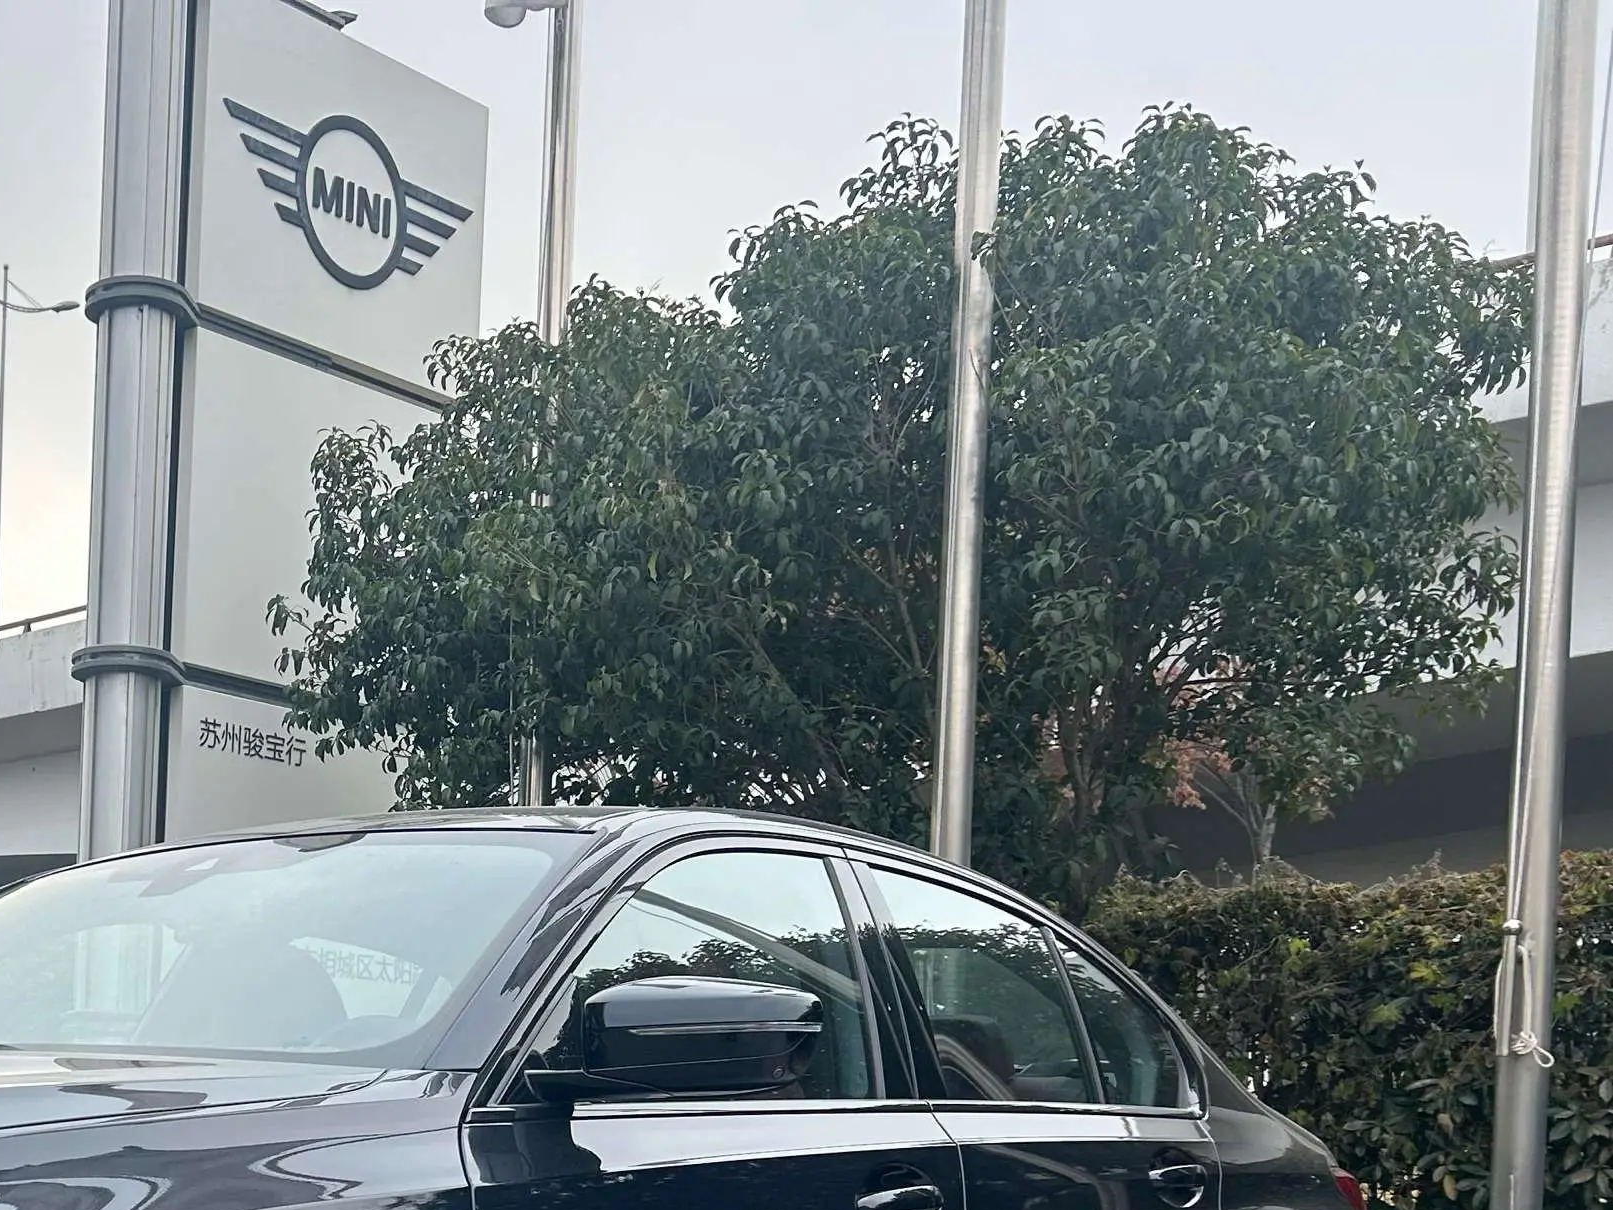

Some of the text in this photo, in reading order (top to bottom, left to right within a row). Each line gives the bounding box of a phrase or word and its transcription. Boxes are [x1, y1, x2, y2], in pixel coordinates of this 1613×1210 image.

[312, 166, 392, 239] MINI
[198, 717, 307, 768] 苏州骏宝行
